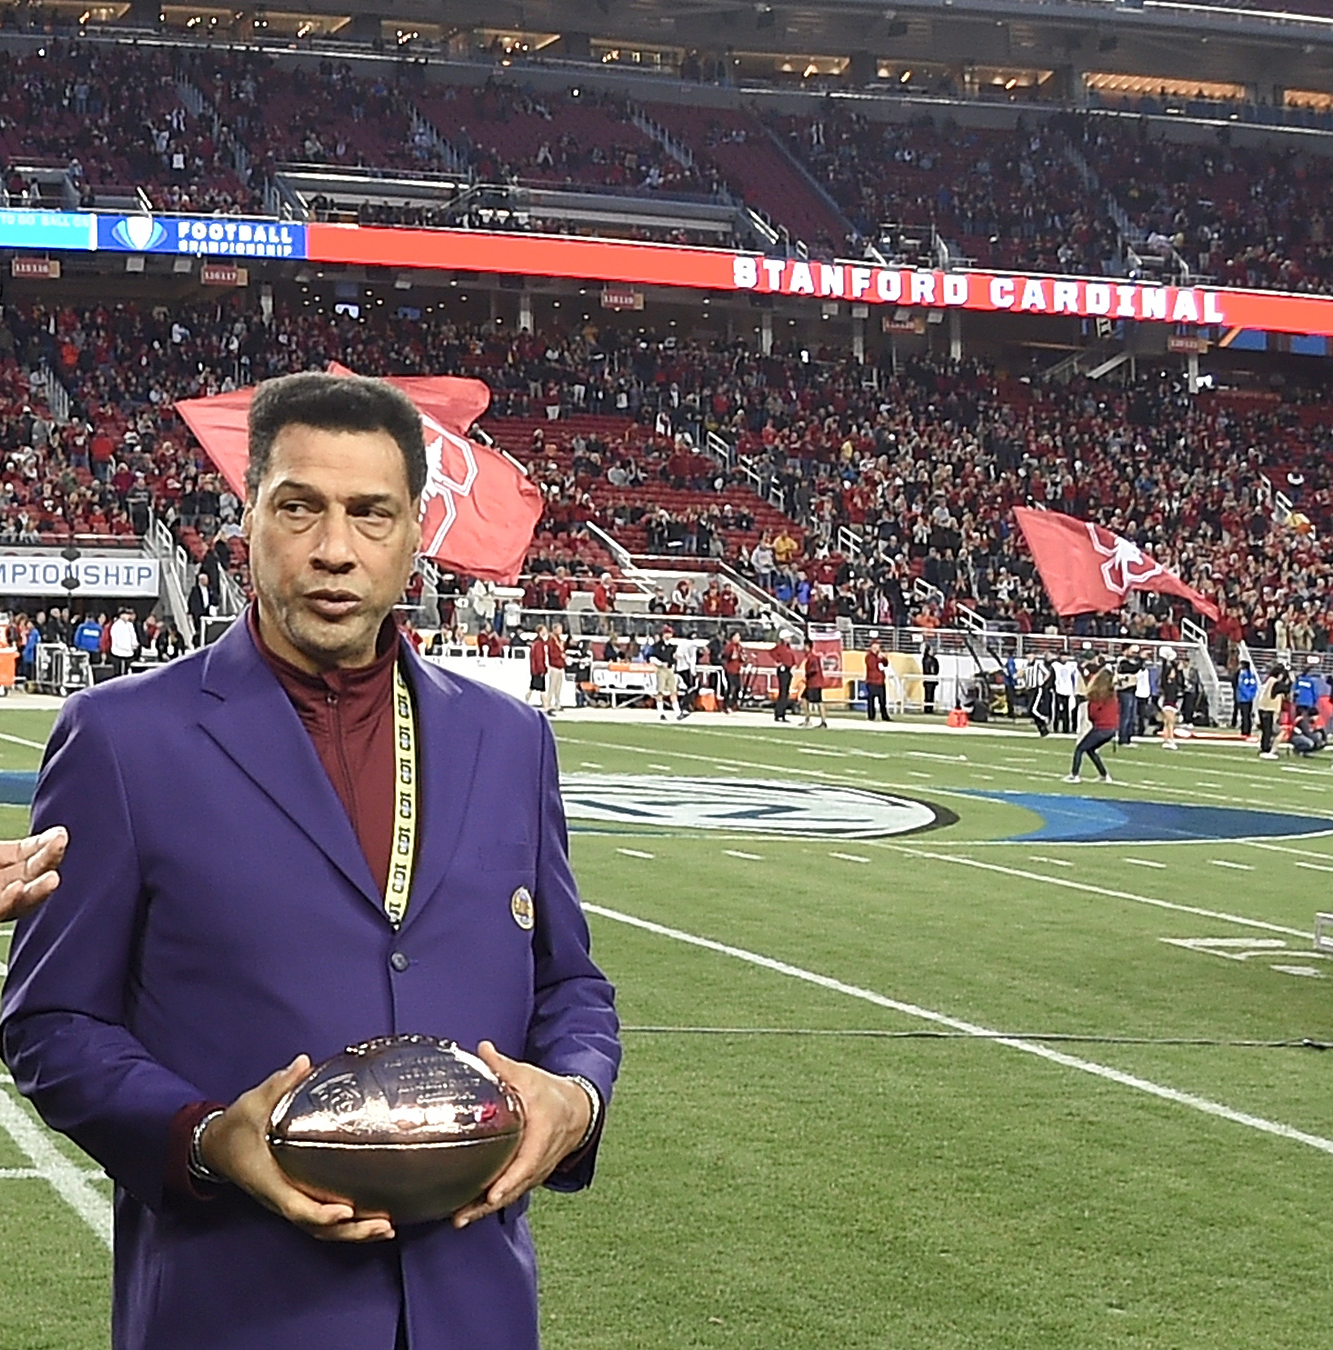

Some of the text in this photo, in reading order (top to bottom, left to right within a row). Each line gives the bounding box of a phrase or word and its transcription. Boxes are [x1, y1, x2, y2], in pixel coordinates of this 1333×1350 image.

[177, 220, 293, 244] FOOTBALL
[733, 256, 1224, 323] STANFORD CARDINAL
